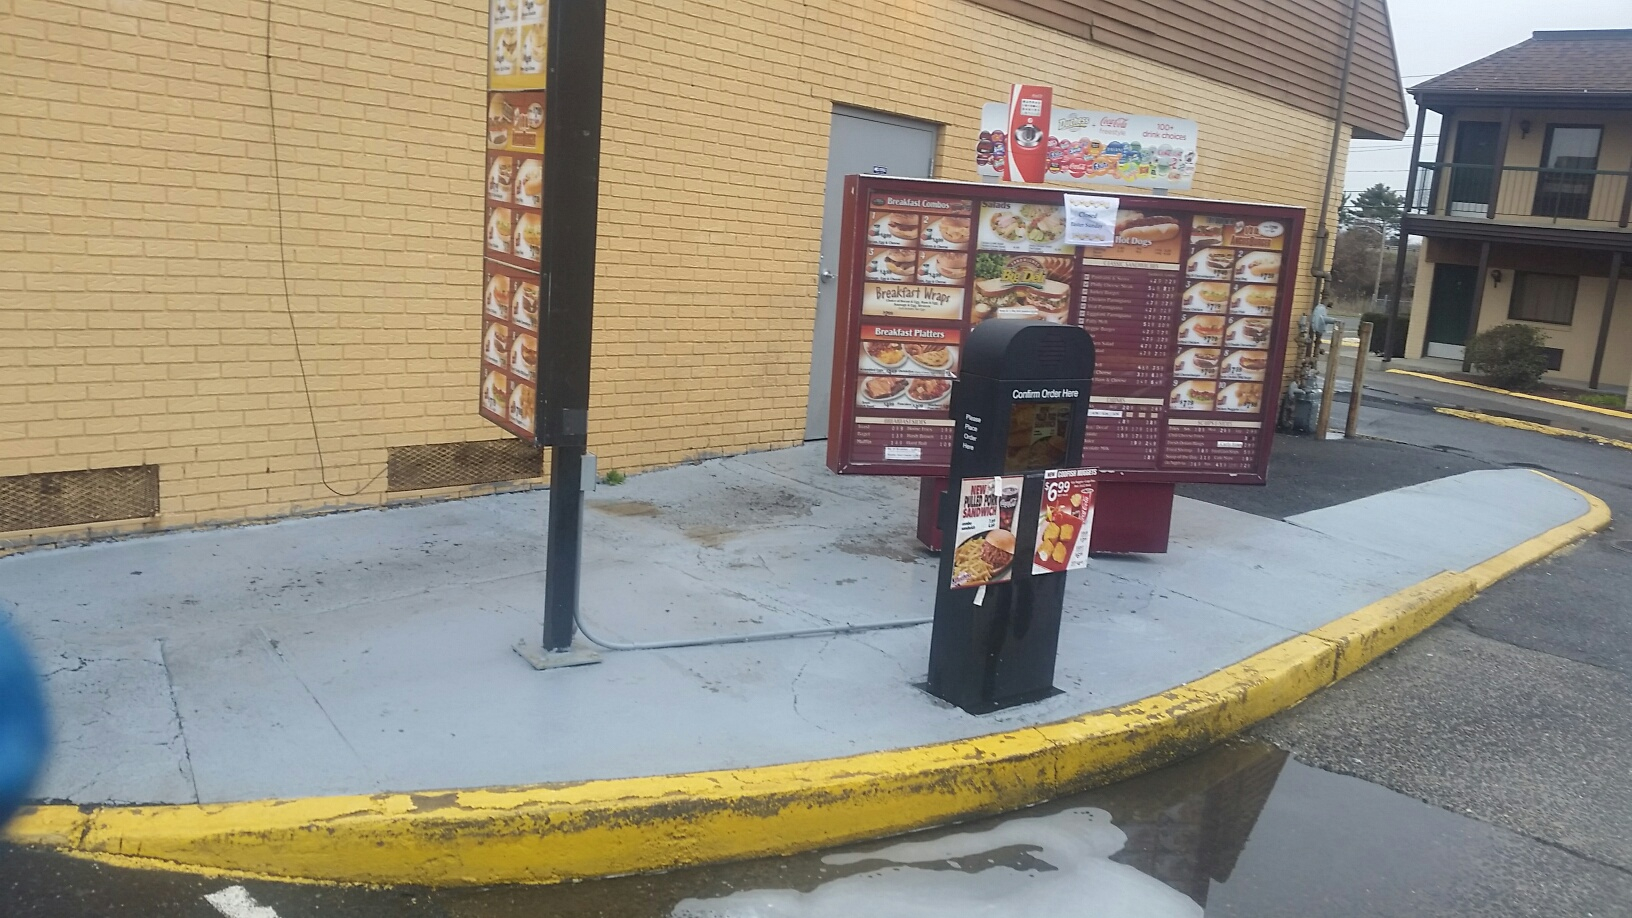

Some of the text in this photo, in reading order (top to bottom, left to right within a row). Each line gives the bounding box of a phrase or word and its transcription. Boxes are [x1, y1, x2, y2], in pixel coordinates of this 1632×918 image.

[1157, 123, 1175, 131] 100+
[1142, 131, 1187, 141] drink choices
[888, 197, 950, 209] Breakfast Combos
[982, 201, 1011, 209] Salads
[1115, 236, 1152, 246] Hot Dogs
[1001, 269, 1046, 284] Big Deli
[876, 286, 951, 306] Breakfast Wraps
[874, 328, 945, 339] Breakfast Platters
[1218, 381, 1227, 389] 10
[1012, 388, 1079, 399] Confirm Order Here
[965, 413, 982, 423] Please
[964, 424, 978, 432] Place
[964, 433, 978, 442] Order
[962, 442, 974, 451] Here
[1058, 470, 1077, 478] CODFISH
[1077, 468, 1098, 476] NUGGETS
[971, 484, 988, 496] NEW
[964, 495, 998, 508] PULLED PORK
[962, 506, 997, 519] SANDWICH
